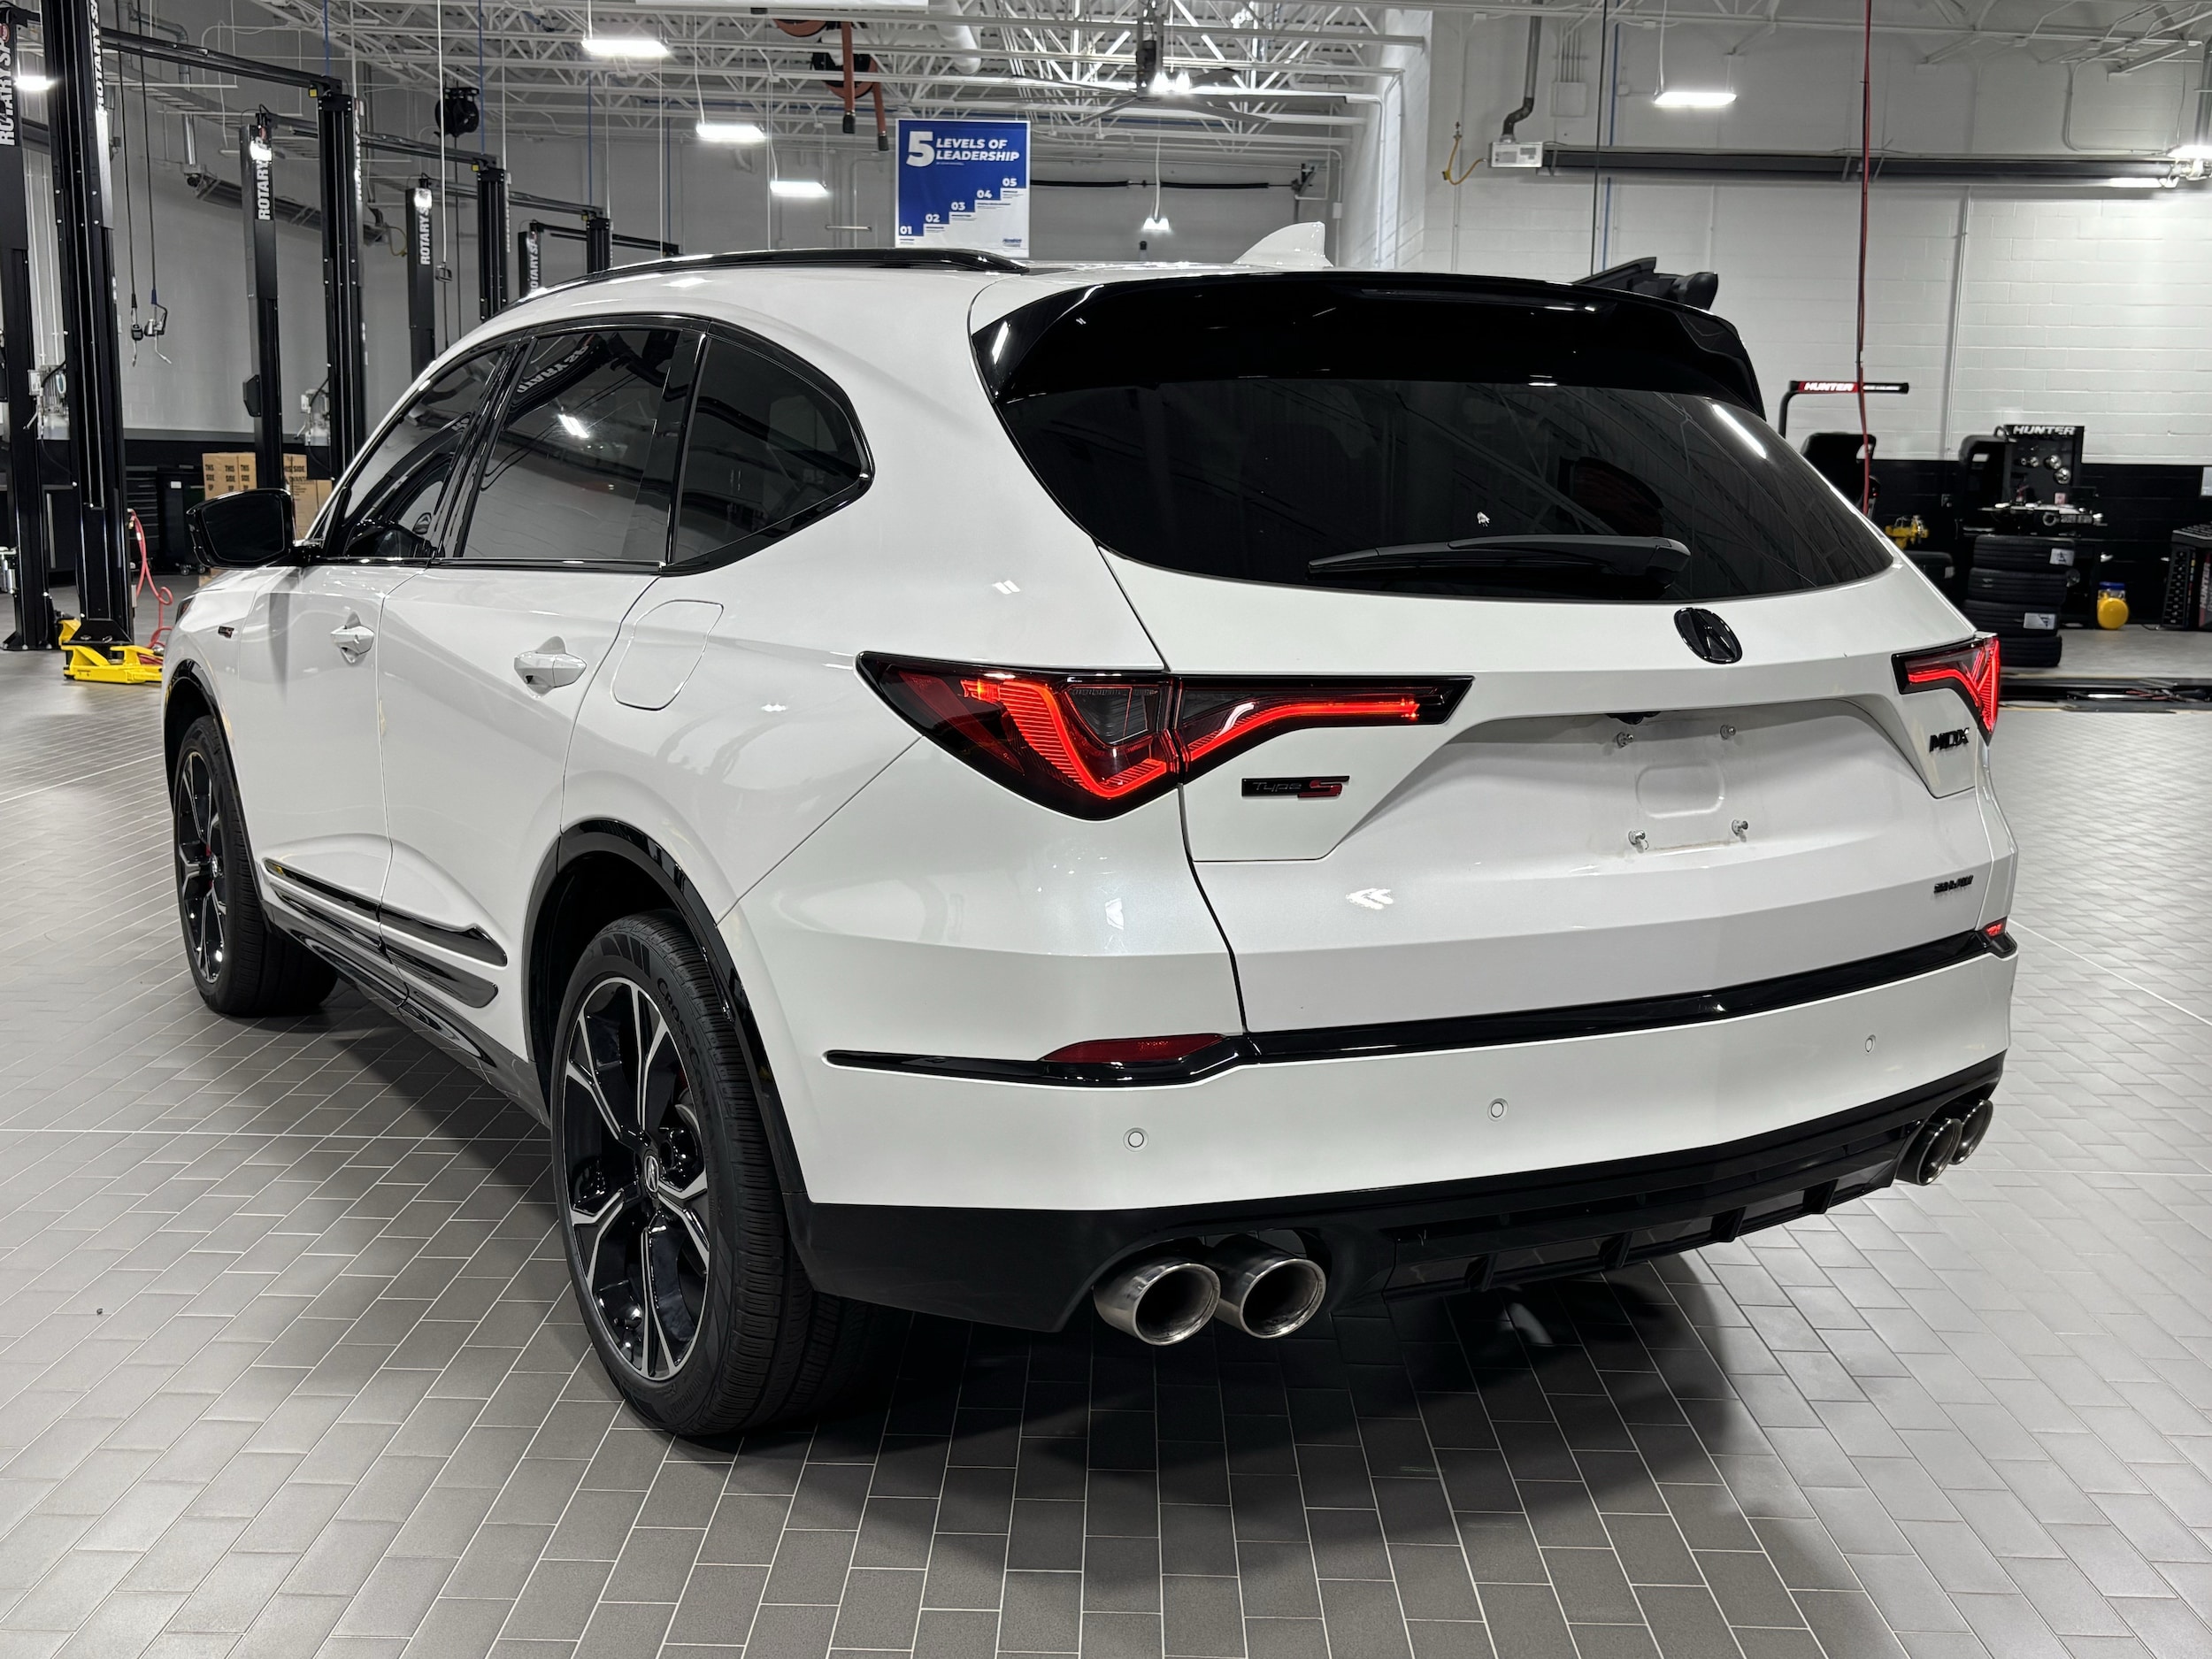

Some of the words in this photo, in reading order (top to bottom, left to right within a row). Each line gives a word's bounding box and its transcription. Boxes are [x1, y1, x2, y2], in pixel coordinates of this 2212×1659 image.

[0, 68, 15, 146] ROTARY
[906, 131, 934, 167] 5
[936, 138, 986, 149] LEVELS
[988, 139, 1008, 150] OF
[936, 150, 1020, 162] LEADERSHIP
[1002, 178, 1017, 187] 05
[256, 159, 271, 220] ROTARY
[976, 189, 992, 198] 04
[951, 202, 965, 211] 03
[900, 226, 912, 234] 01
[419, 217, 431, 265] ROTARY
[1804, 382, 1855, 391] HUNTER
[2013, 426, 2076, 435] HUNTER
[2200, 562, 2211, 610] HUNTER
[1929, 727, 1970, 752] MDX
[1297, 776, 1349, 798] S
